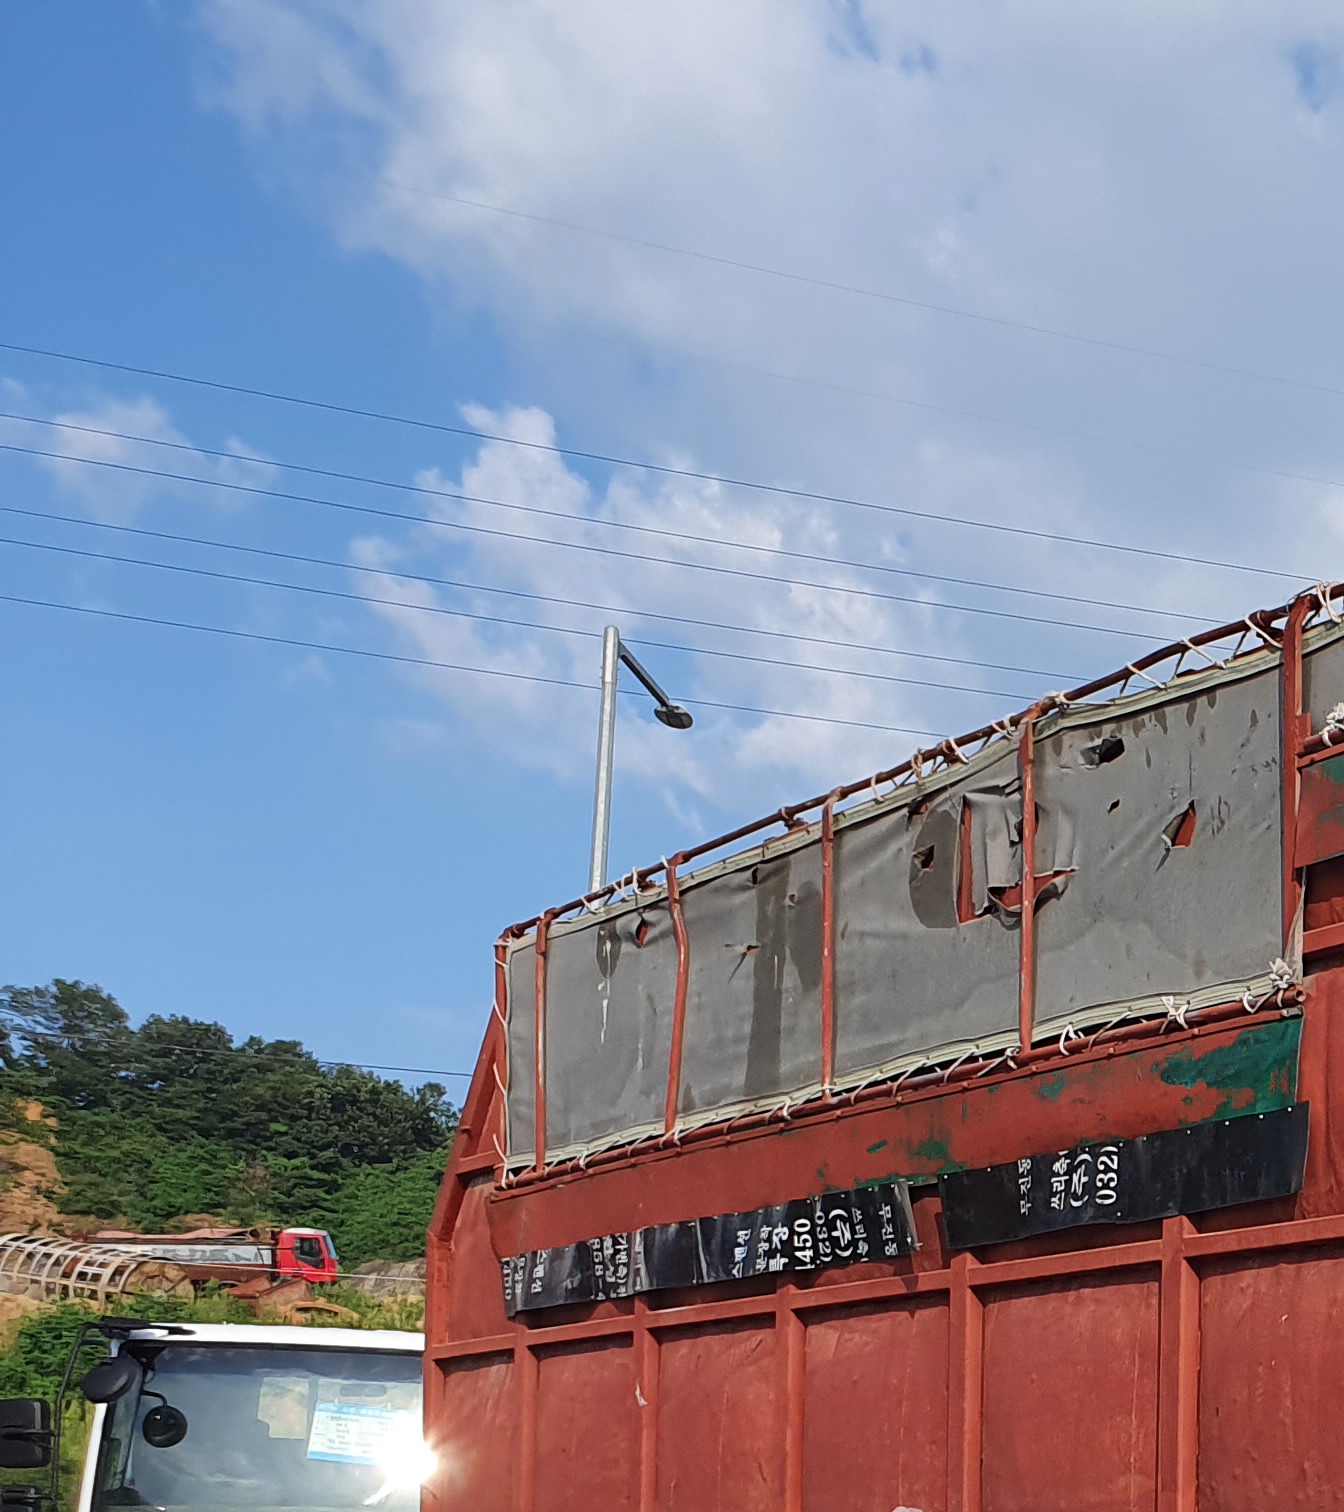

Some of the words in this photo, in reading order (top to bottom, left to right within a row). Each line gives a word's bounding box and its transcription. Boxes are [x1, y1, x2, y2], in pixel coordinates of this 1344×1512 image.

[1069, 1153, 1093, 1208] (주)
[1095, 1145, 1119, 1206] 032)
[828, 1208, 853, 1258] (주)
